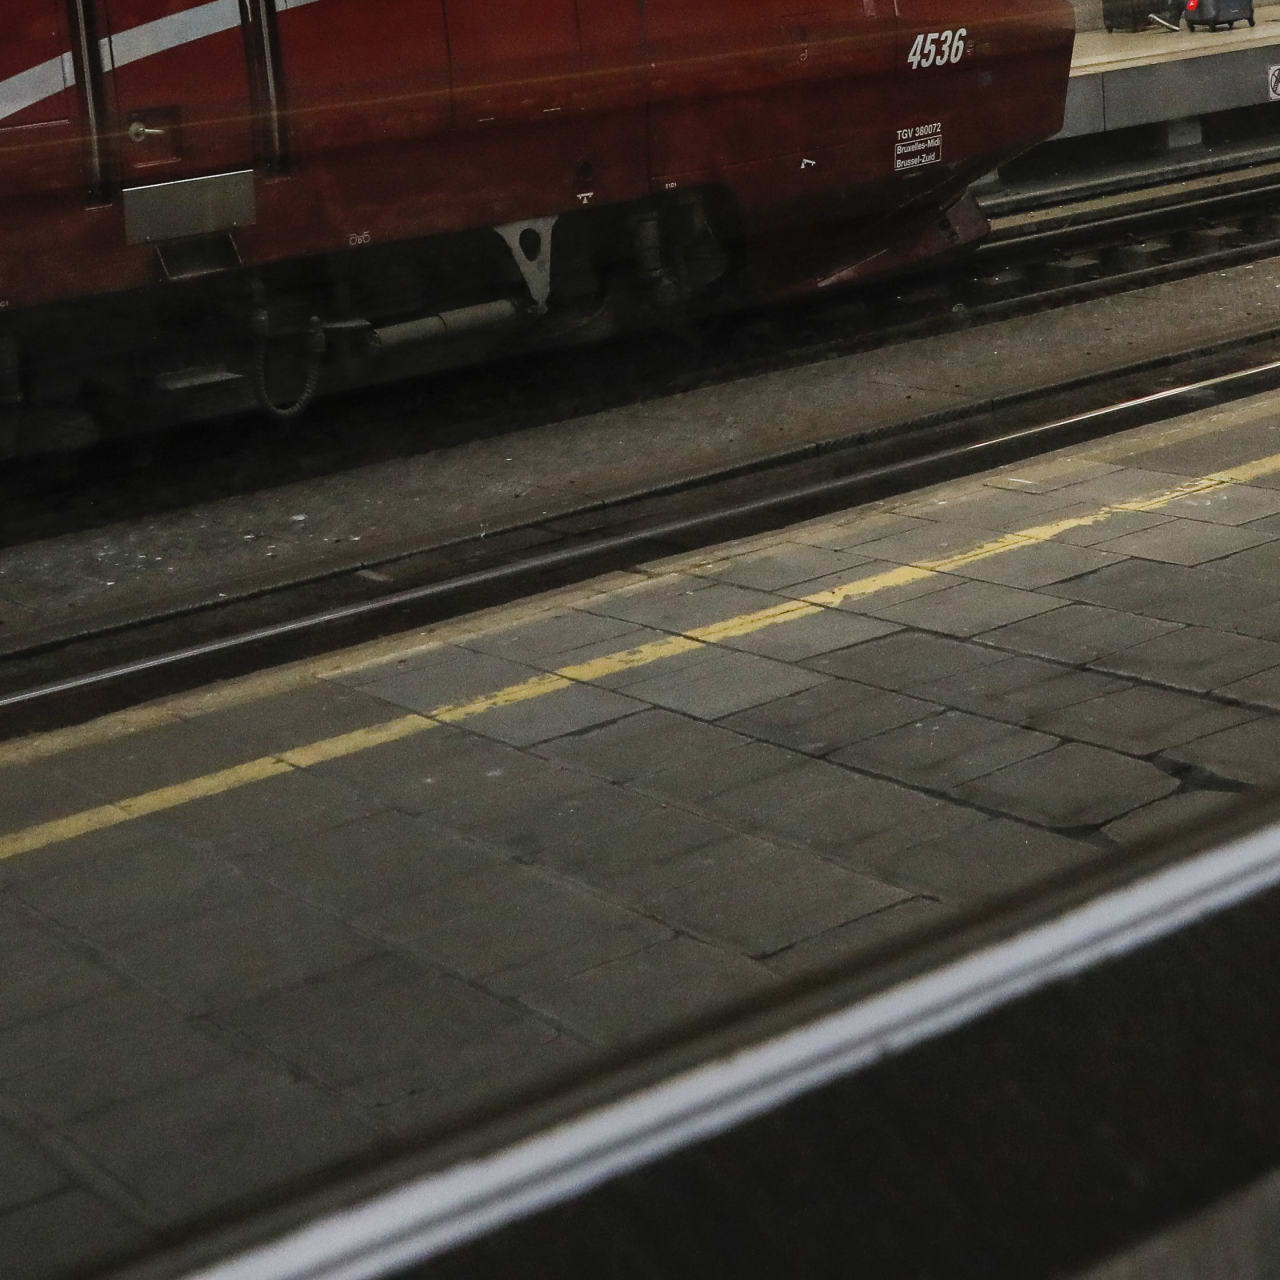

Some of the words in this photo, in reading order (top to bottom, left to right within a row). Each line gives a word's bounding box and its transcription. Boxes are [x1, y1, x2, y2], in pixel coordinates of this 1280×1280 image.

[907, 27, 968, 70] 4536
[896, 128, 913, 141] TGV
[915, 122, 942, 137] 380072
[897, 138, 941, 154] Bruxelles-Midi
[896, 152, 936, 168] Brussel-Zuid
